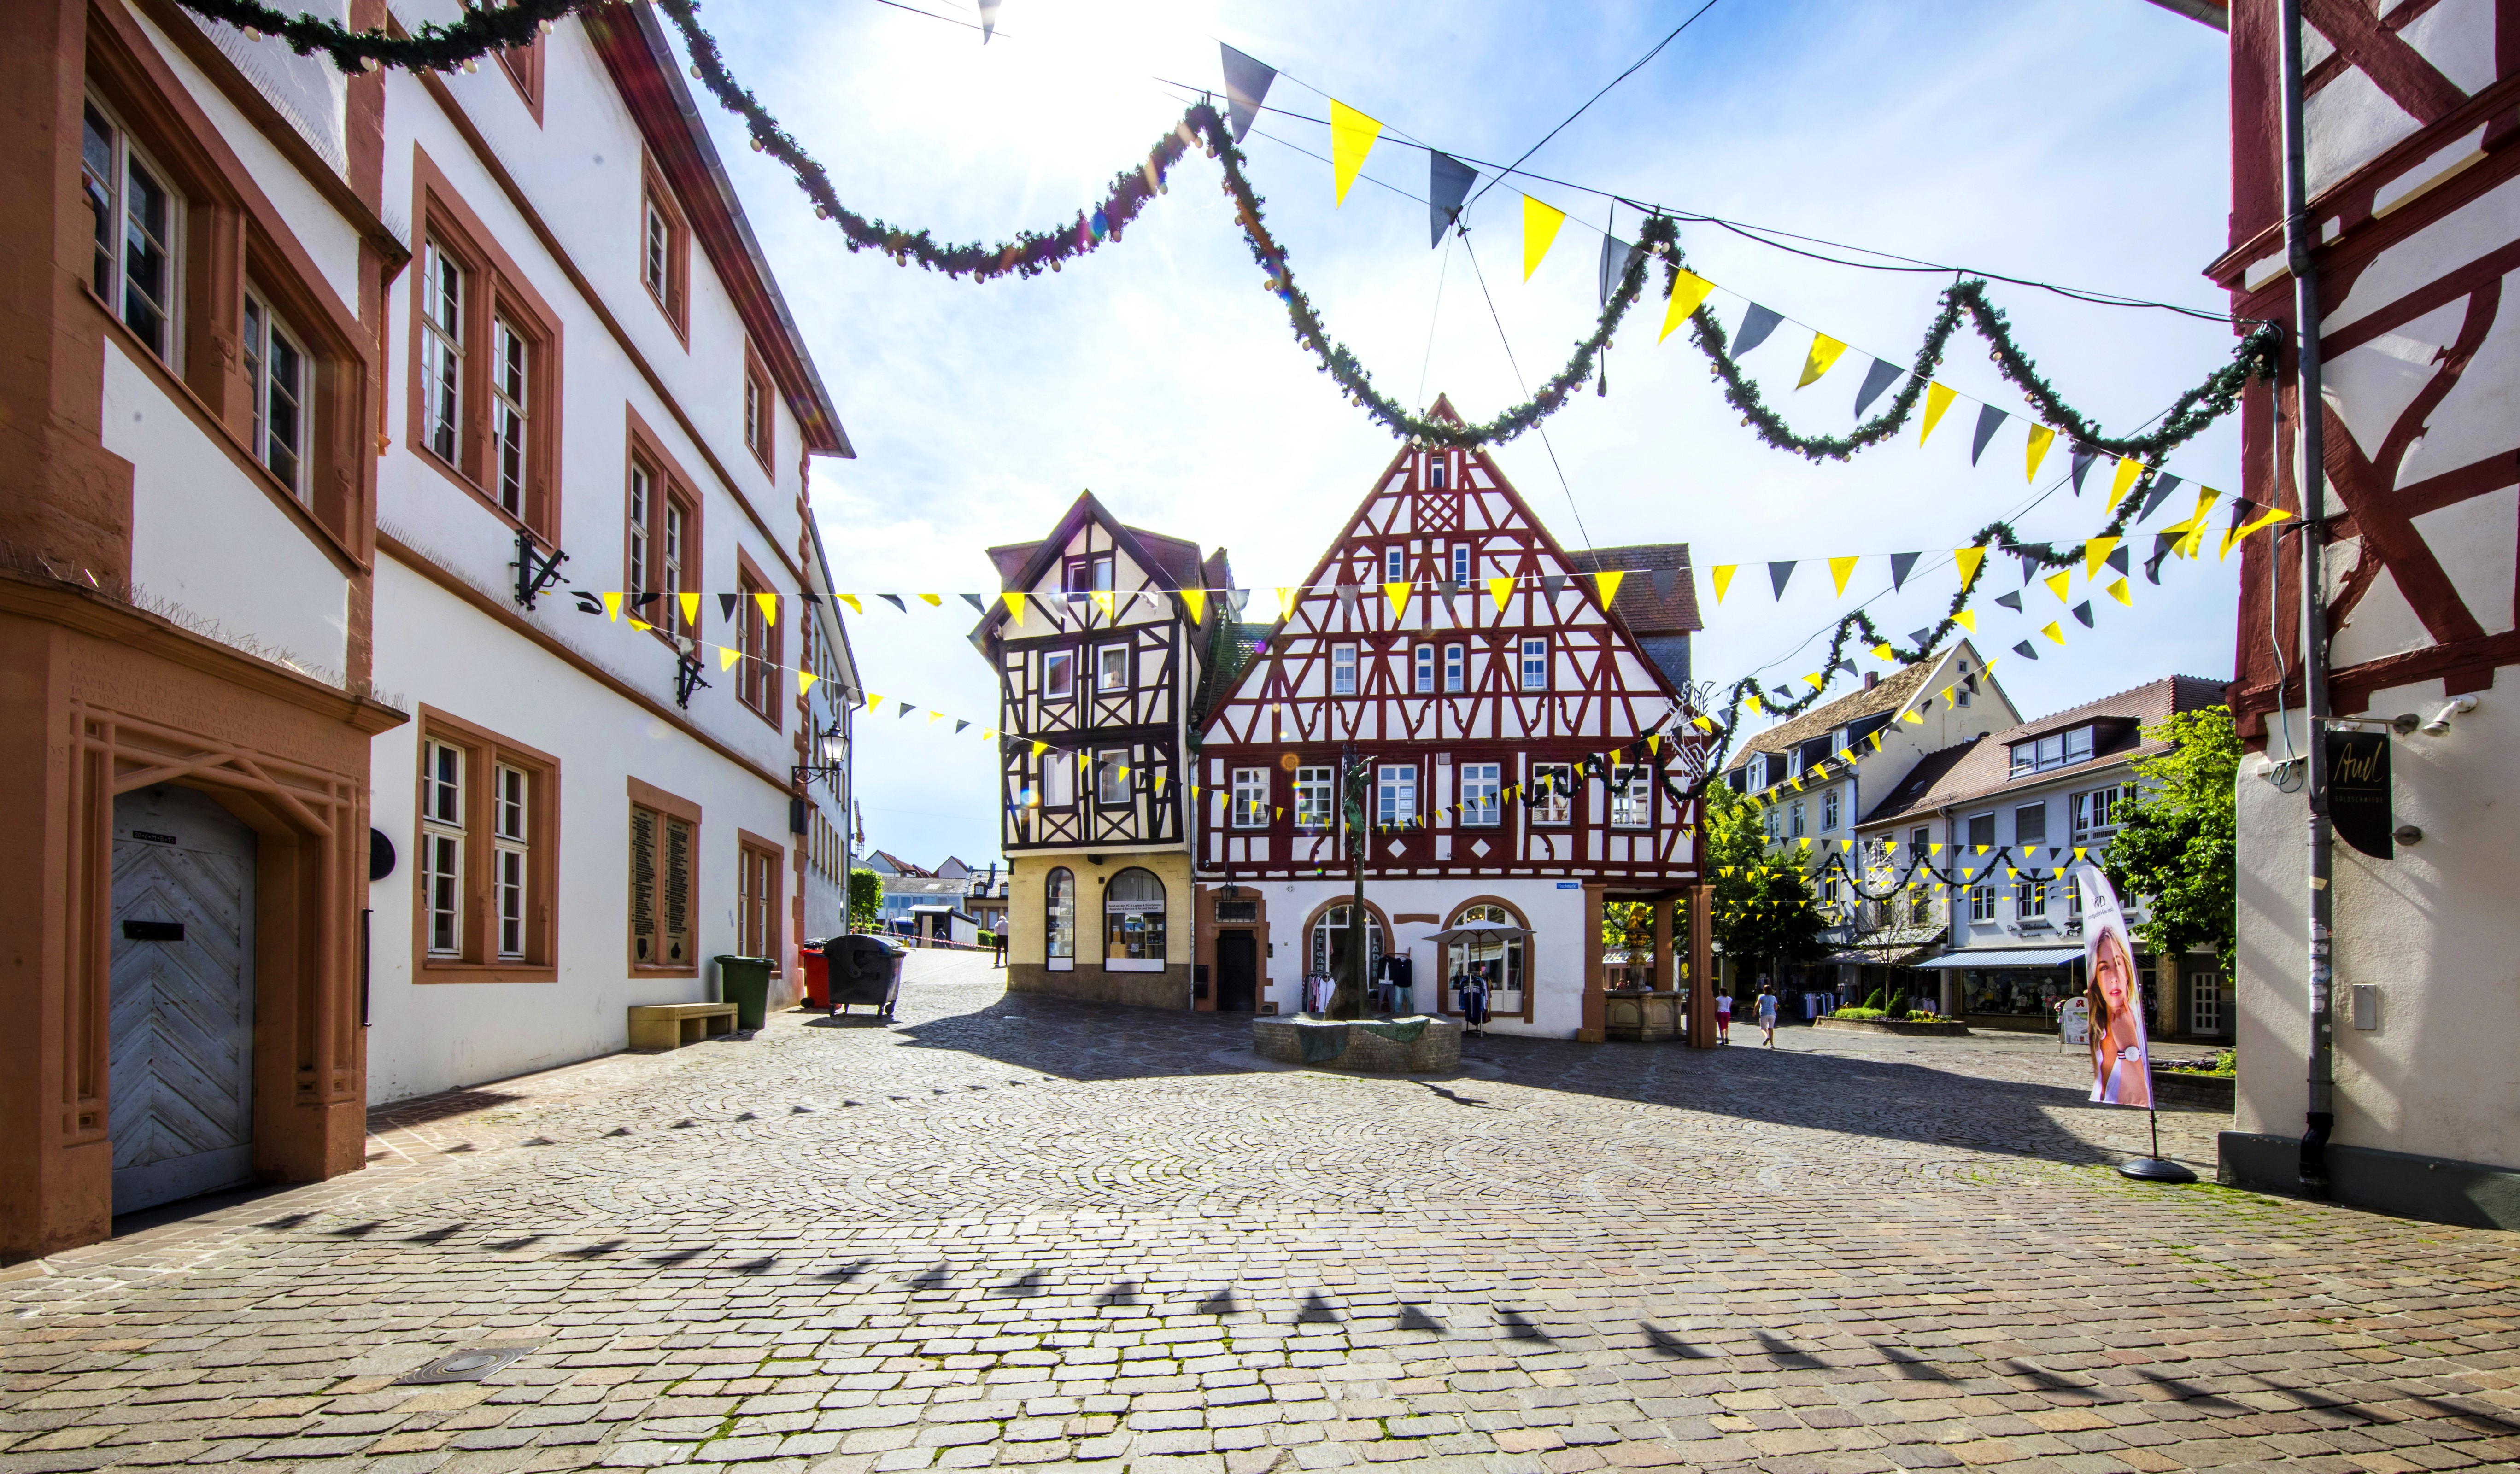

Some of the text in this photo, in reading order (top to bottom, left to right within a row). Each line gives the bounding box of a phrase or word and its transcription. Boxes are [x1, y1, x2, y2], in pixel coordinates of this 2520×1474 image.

[70, 684, 120, 708] JACOBO
[123, 699, 165, 721] COQVO
[135, 690, 166, 709] LAPIS
[218, 715, 278, 742] DVODECIMO
[180, 692, 253, 724] OCTVAGESIMO
[258, 716, 286, 734] SEXTO
